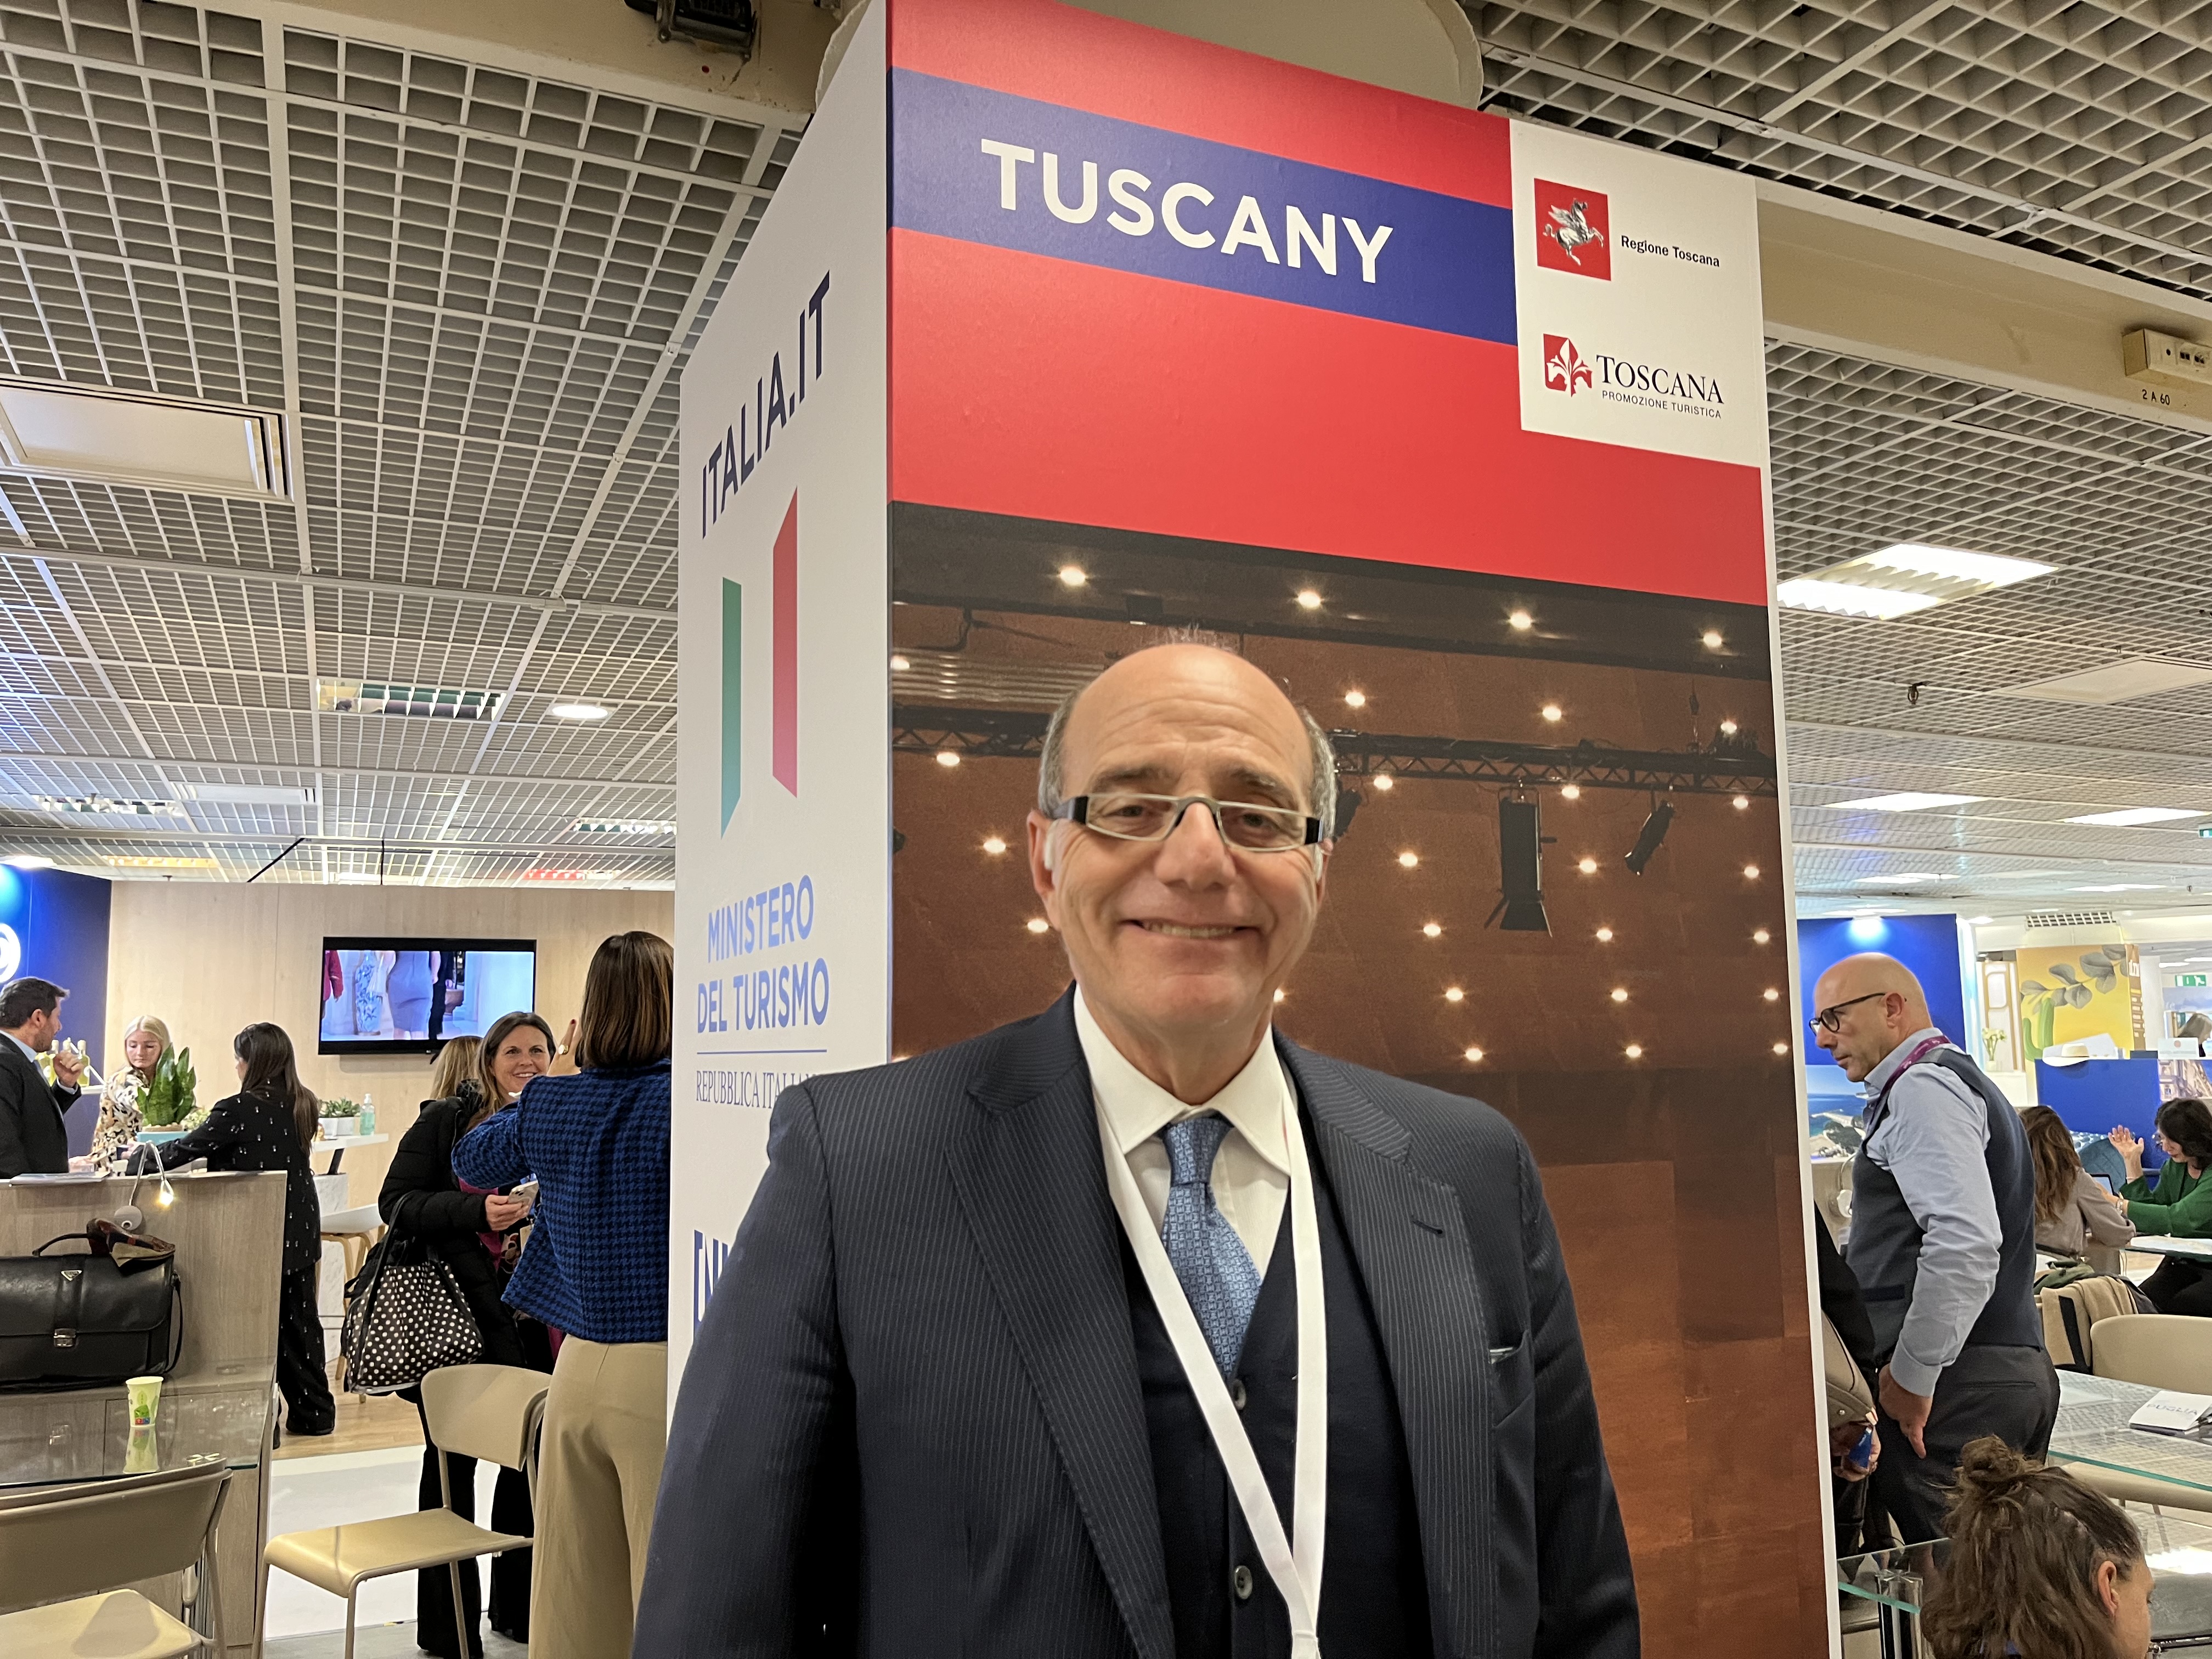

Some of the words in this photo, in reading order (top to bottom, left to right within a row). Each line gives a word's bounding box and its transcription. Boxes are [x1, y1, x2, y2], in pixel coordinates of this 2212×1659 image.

[981, 138, 1393, 284] TUSCANY
[1621, 235, 1669, 256] Regione
[1672, 246, 1720, 267] Toscana
[1596, 354, 1725, 404] TOSCANA
[2151, 391, 2157, 403] A
[2160, 393, 2170, 405] 60
[702, 269, 830, 540] ITALIA.IT
[1602, 390, 1668, 410] PROMOZIONE
[1671, 402, 1722, 419] TURISTICA
[708, 874, 814, 964] MINISTERO
[697, 979, 727, 1034] DEL
[733, 957, 830, 1031] TURISMO
[696, 1070, 760, 1108] REPUBBLICA
